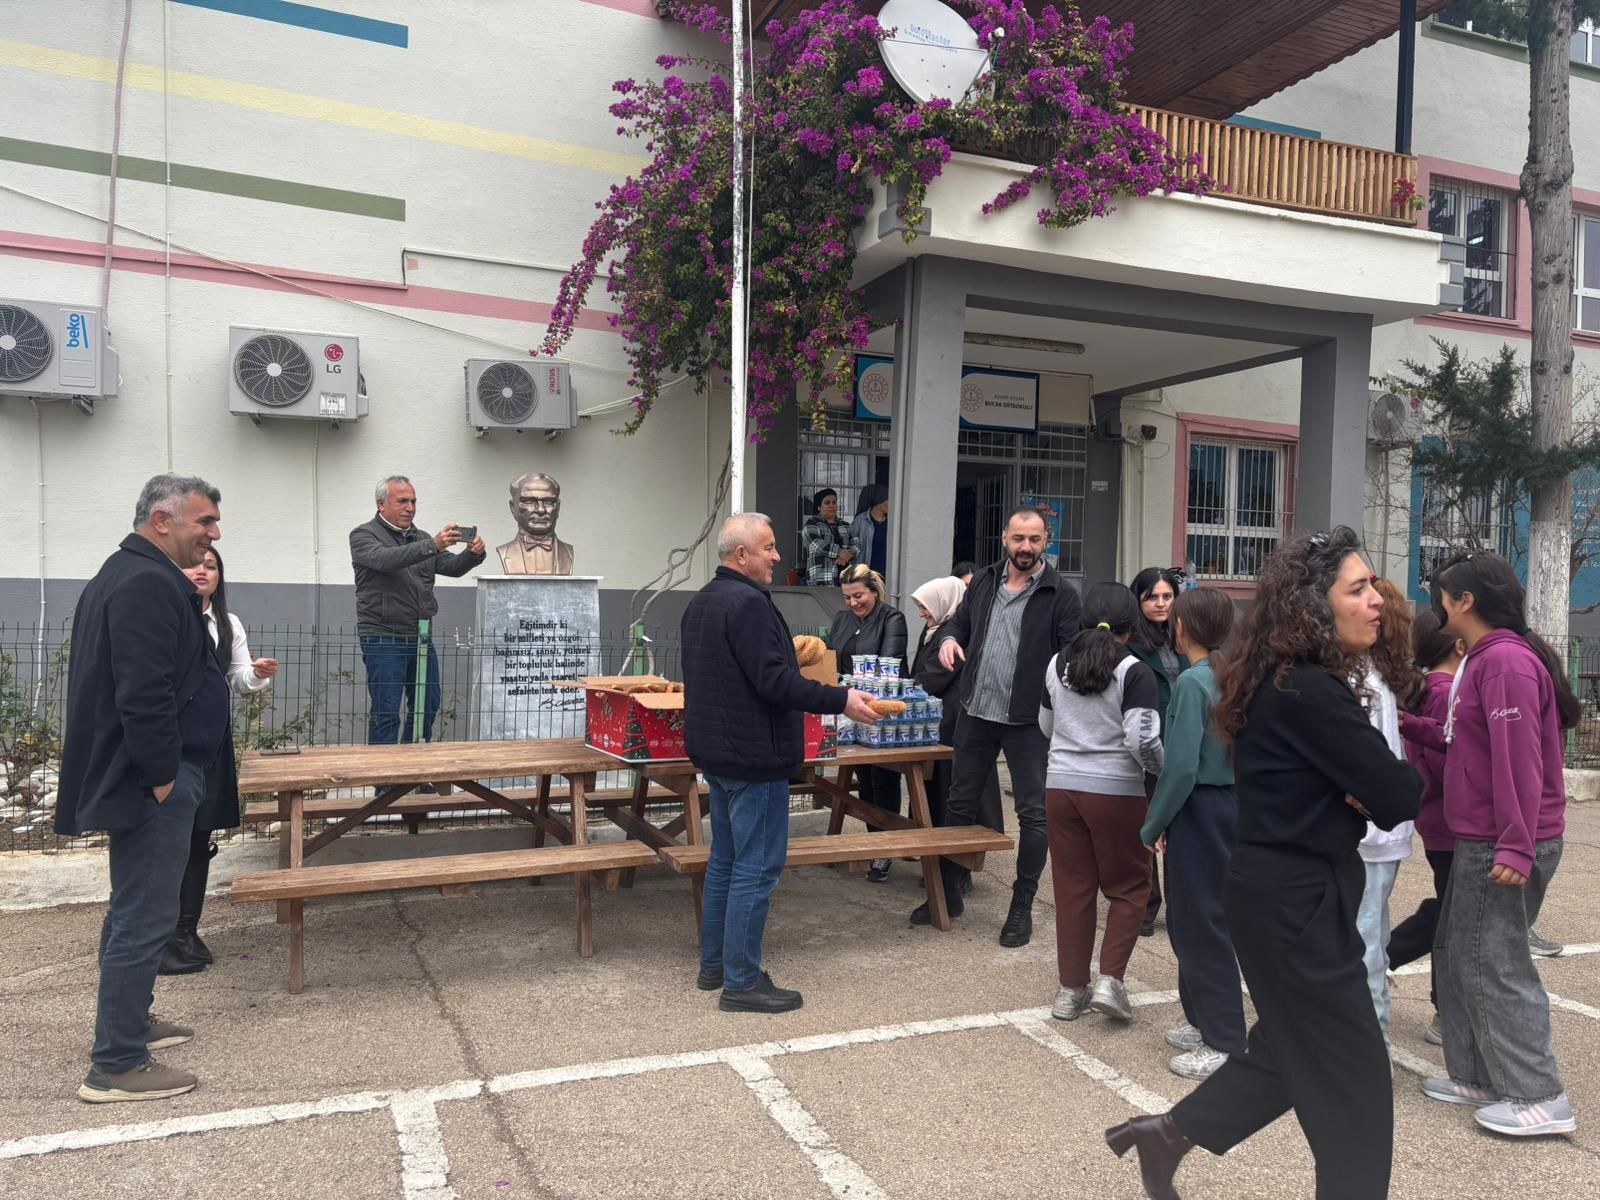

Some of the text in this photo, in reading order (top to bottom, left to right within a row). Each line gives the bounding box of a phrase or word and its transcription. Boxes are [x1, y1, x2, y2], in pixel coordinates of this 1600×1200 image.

[66, 313, 80, 348] beko
[326, 364, 342, 374] LG
[984, 400, 1003, 408] BUCAK
[520, 619, 568, 631] Eğitimdir ki
[504, 633, 517, 643] bir
[547, 636, 556, 644] ya
[504, 658, 586, 670] bir topluluk halinde
[508, 685, 540, 696] sefalete
[541, 684, 559, 694] terk
